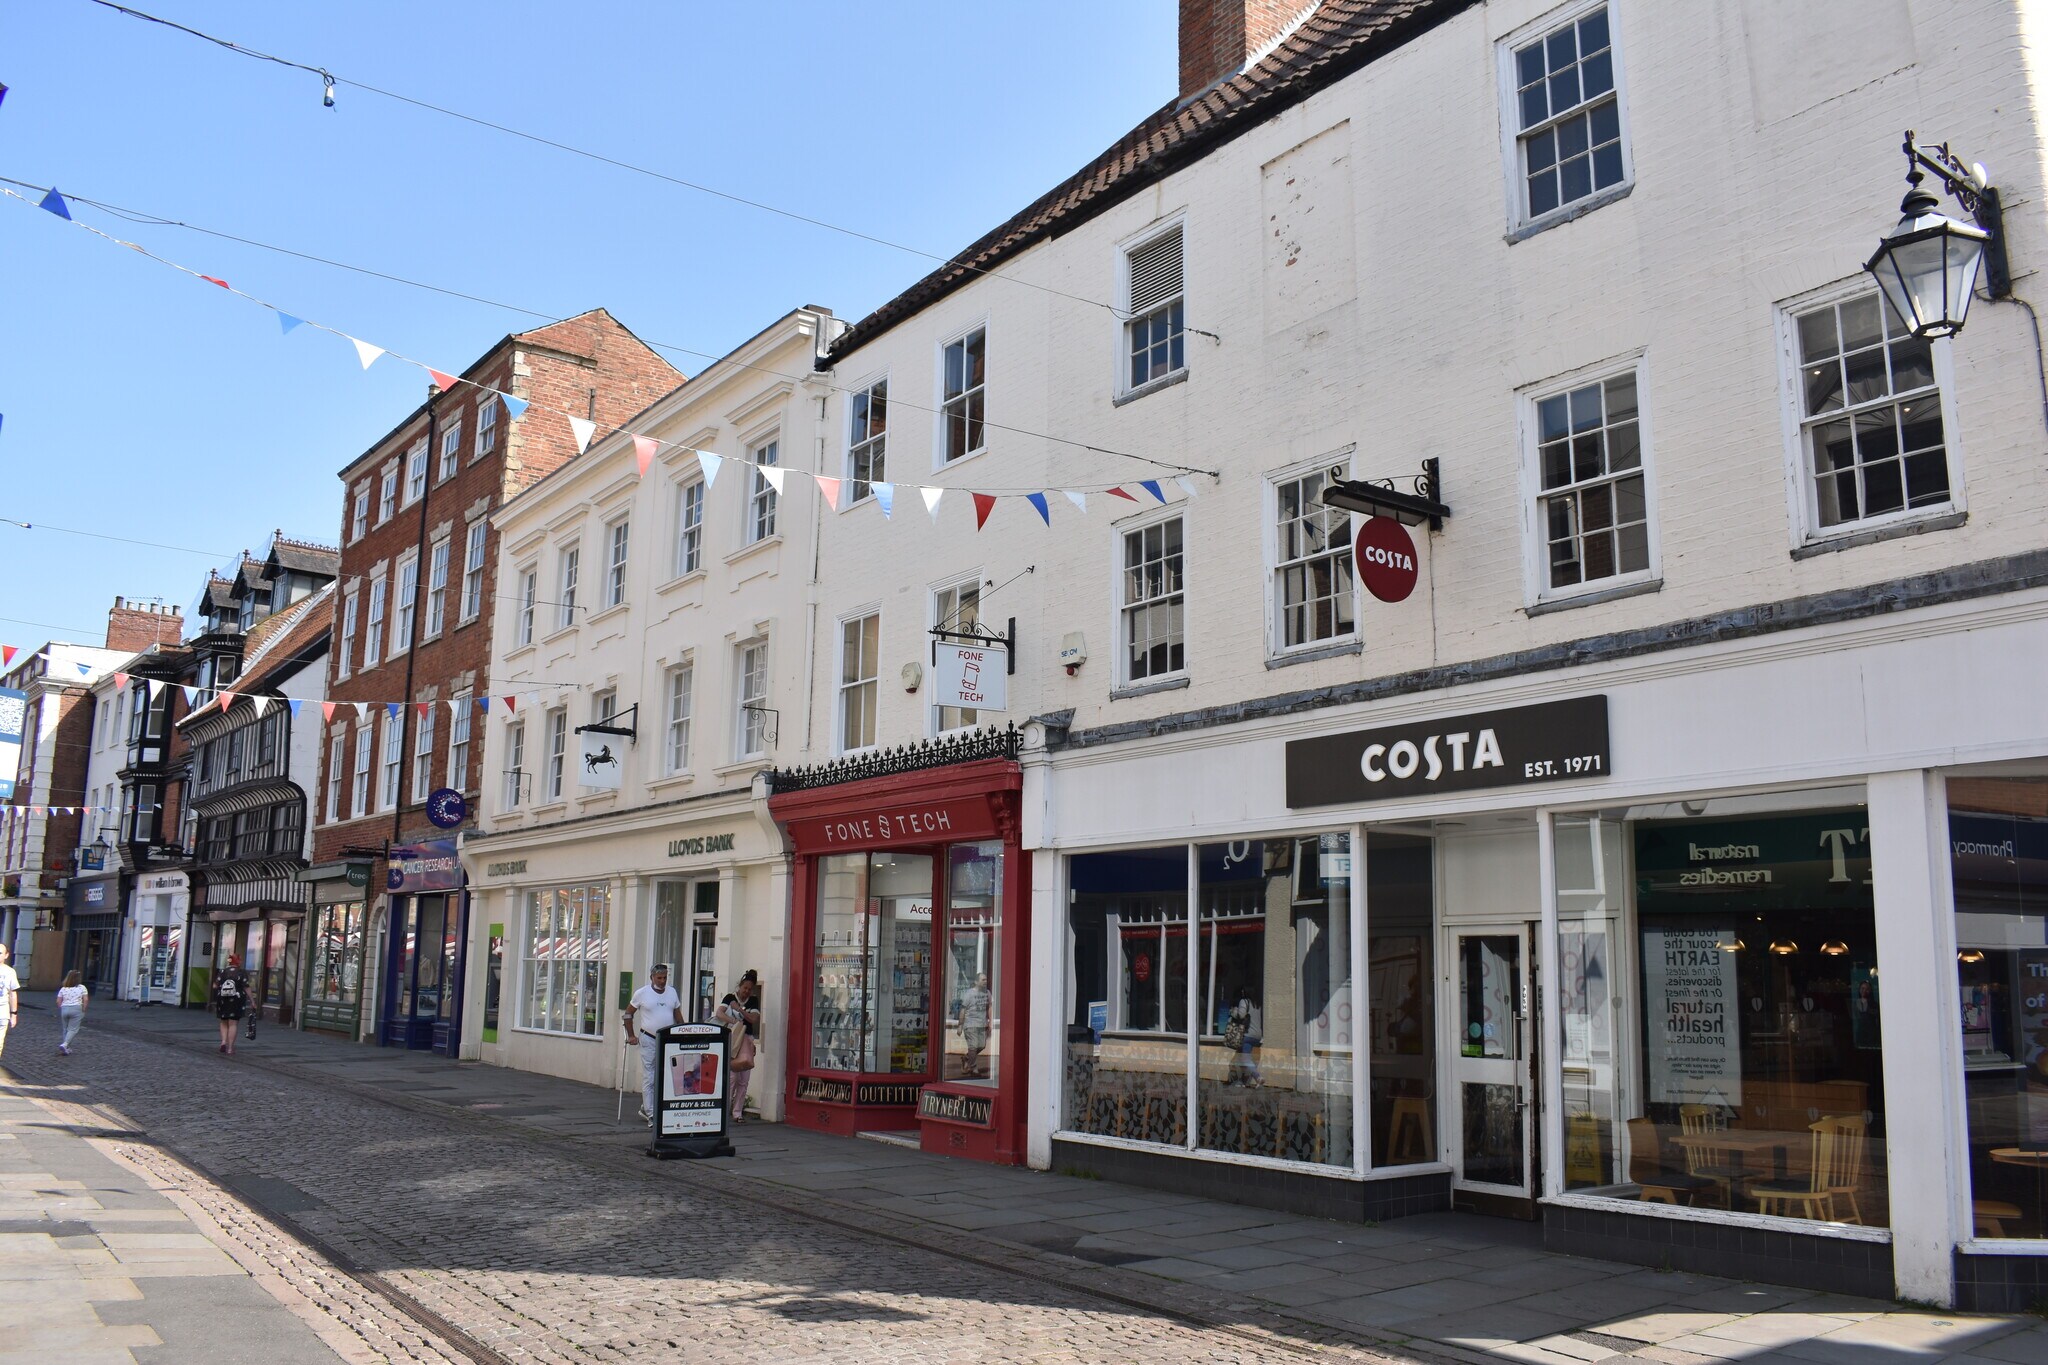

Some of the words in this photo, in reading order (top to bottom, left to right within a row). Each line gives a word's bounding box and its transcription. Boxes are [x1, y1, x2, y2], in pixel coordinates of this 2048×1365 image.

[1365, 546, 1413, 571] COSTA
[958, 650, 984, 662] FONE
[958, 691, 984, 702] TECH
[1361, 728, 1504, 782] COSTA
[1525, 760, 1558, 778] EST.
[1564, 755, 1601, 774] 1971
[825, 820, 874, 842] FONE
[895, 810, 951, 834] TECH
[668, 837, 704, 858] LLOYDS
[705, 833, 735, 853] BANK
[403, 860, 423, 875] CANCER
[424, 856, 453, 872] RESEARCH
[487, 862, 510, 877] LLOYDS
[510, 860, 528, 875] BANK
[924, 1095, 960, 1117] TRYNER
[961, 1100, 990, 1121] LYNN
